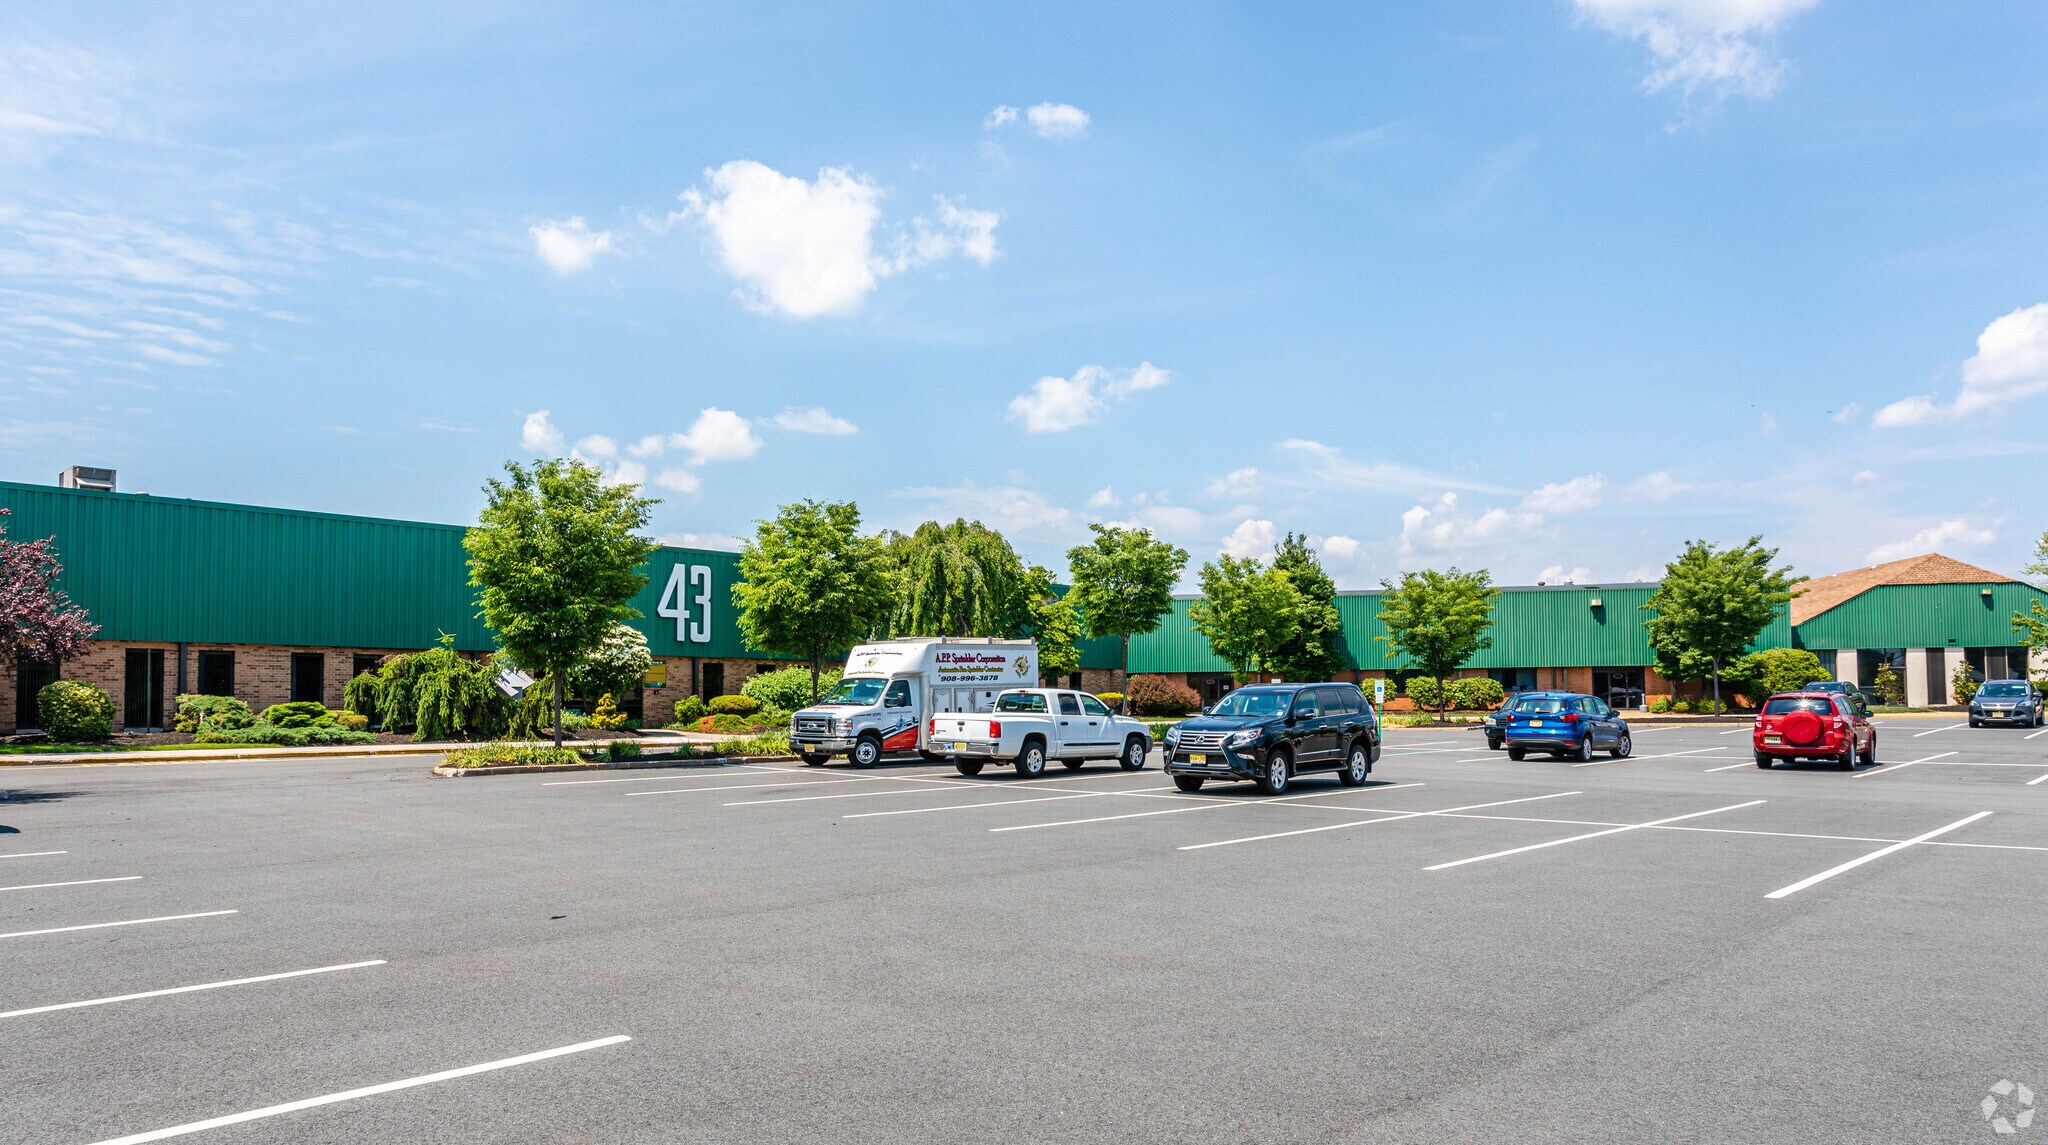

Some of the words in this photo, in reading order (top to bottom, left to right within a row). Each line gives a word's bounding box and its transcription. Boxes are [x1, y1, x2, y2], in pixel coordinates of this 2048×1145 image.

[657, 562, 712, 643] 43
[952, 653, 975, 664] Sprinkler
[976, 653, 1006, 664] Corporation
